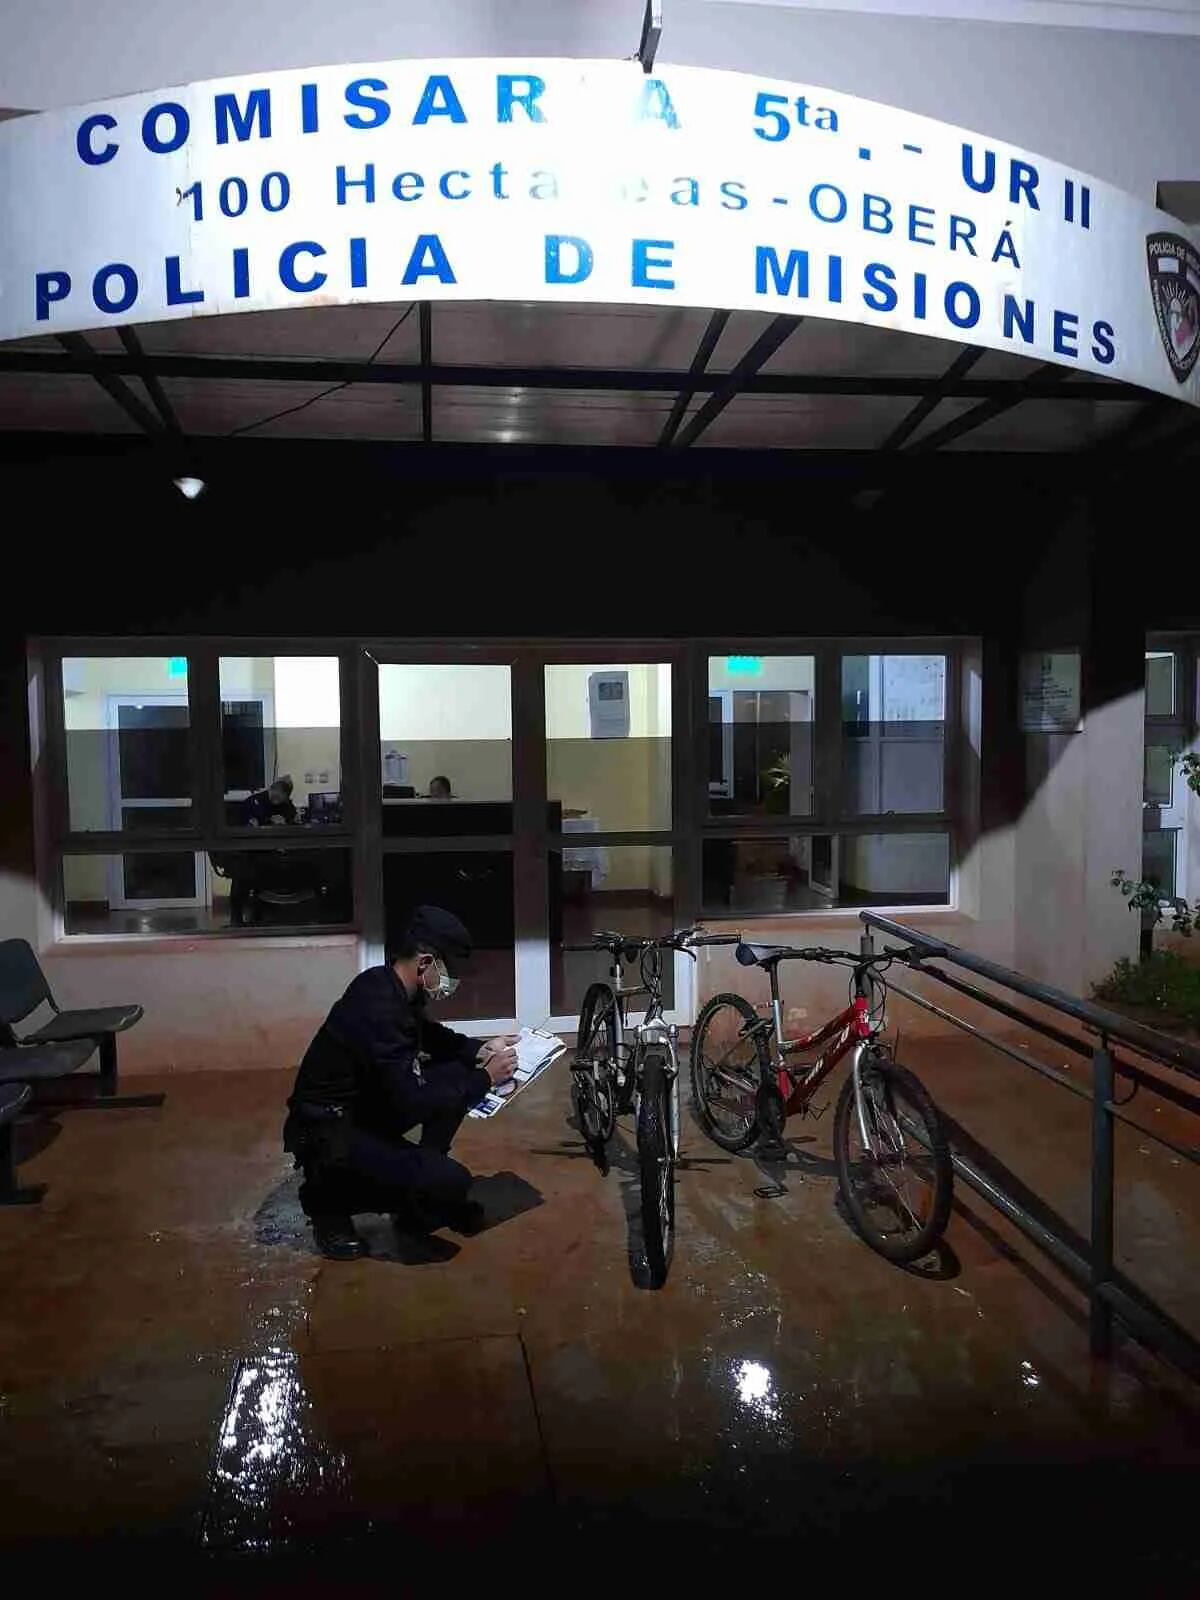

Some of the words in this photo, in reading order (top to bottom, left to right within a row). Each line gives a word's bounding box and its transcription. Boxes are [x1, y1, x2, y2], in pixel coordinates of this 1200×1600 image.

[75, 73, 681, 167] COMISARA
[962, 143, 1040, 211] UR
[1063, 177, 1091, 230] II
[187, 171, 290, 222] 100
[34, 233, 458, 322] POLICIA
[543, 234, 678, 291] DE
[755, 246, 1116, 365] MISIONES
